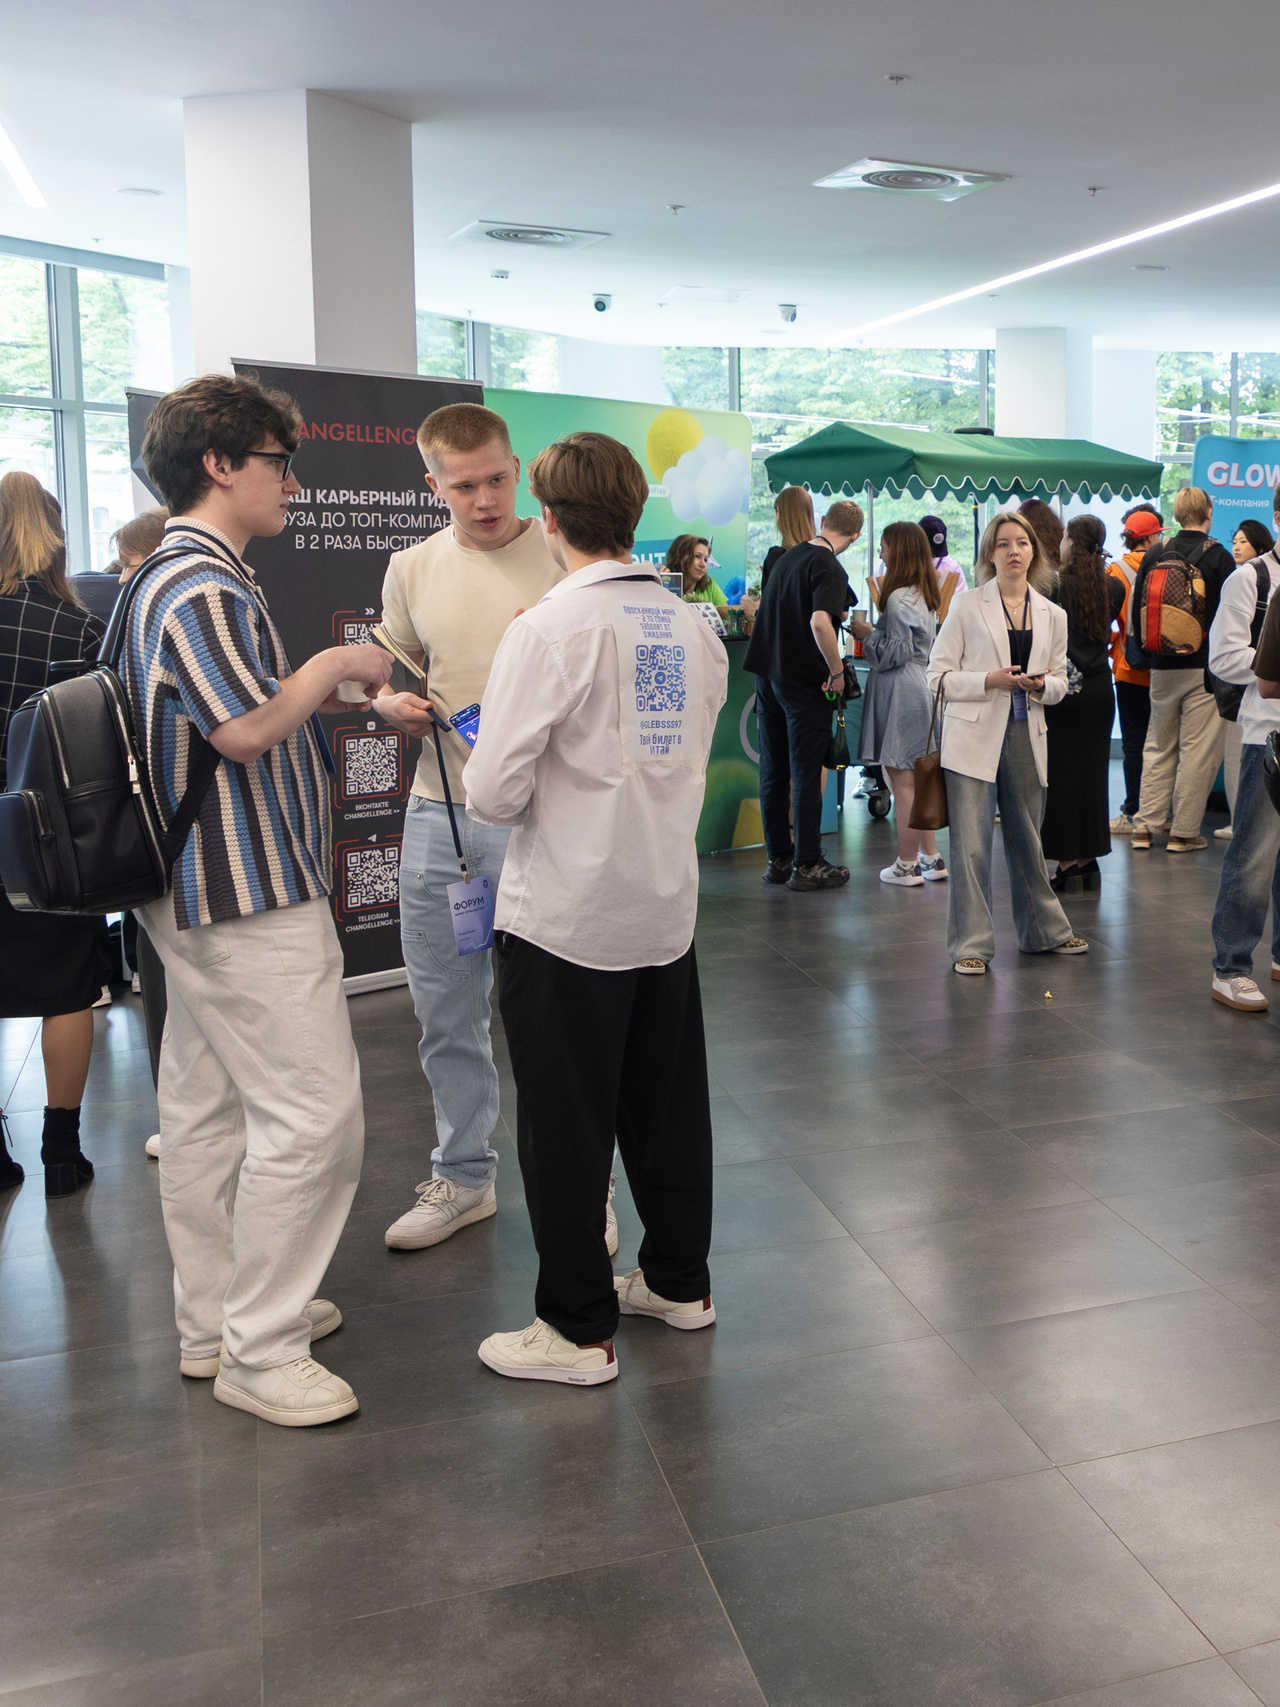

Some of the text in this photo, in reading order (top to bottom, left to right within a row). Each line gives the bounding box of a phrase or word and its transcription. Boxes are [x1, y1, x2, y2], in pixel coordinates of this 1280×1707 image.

[297, 422, 417, 446] ANGELLENG
[288, 488, 311, 504] АШ
[316, 489, 416, 507] КАРЬЕРНЫЙ
[1209, 495, 1270, 508] T-компания
[321, 513, 346, 529] ДО
[349, 512, 453, 529] ТОП-КОМПАН
[296, 535, 305, 549] В
[310, 535, 320, 549] 2
[325, 535, 362, 550] РАЗА
[652, 733, 676, 746] билет
[650, 743, 670, 755] тай
[355, 801, 389, 811] ВКОНТАКТЕ
[344, 808, 393, 820] CHANGELLENGE
[454, 896, 485, 910] ФОРУМ
[358, 912, 389, 922] TELEGRAM
[345, 919, 393, 932] CHANGELLENGE
